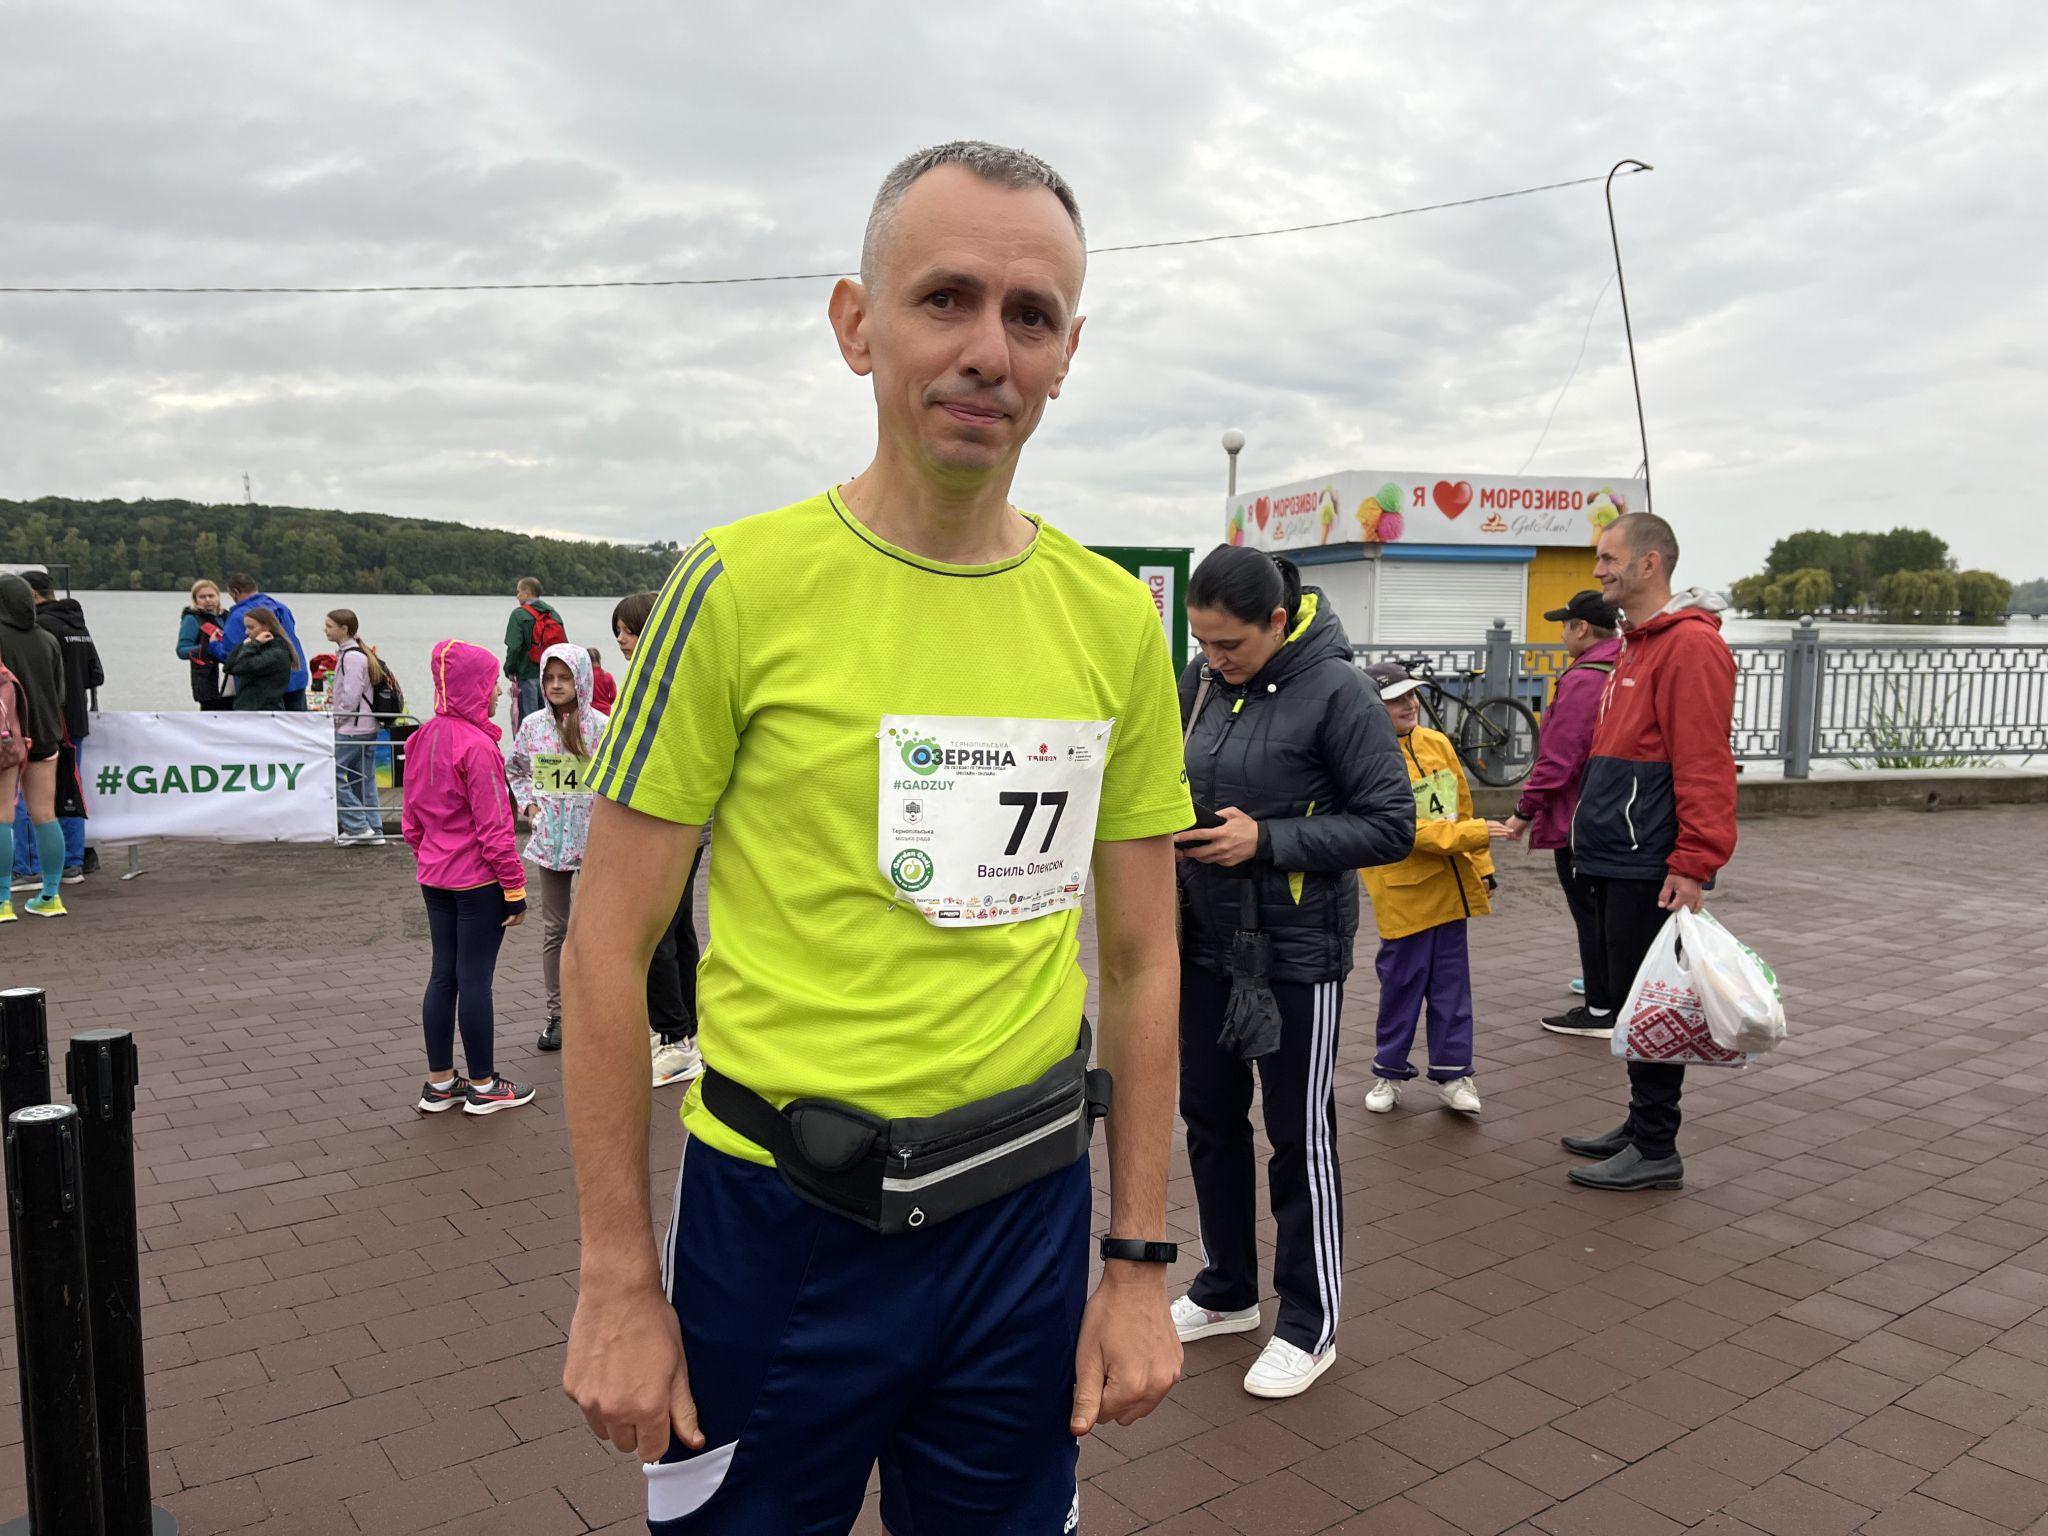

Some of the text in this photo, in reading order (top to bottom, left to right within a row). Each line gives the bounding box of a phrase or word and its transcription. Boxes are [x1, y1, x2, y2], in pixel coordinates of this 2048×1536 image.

[1248, 491, 1317, 523] Я МОРОЗИВО
[1412, 486, 1583, 510] Я МОРОЗИВО
[913, 748, 1016, 767] ОЗЕРЯНА
[96, 763, 305, 795] #GADZUY
[551, 769, 578, 789] 14
[893, 780, 955, 791] #GADZUY
[1430, 792, 1444, 814] 4
[999, 791, 1069, 856] 77
[978, 859, 1065, 878] Василь Олексюк
